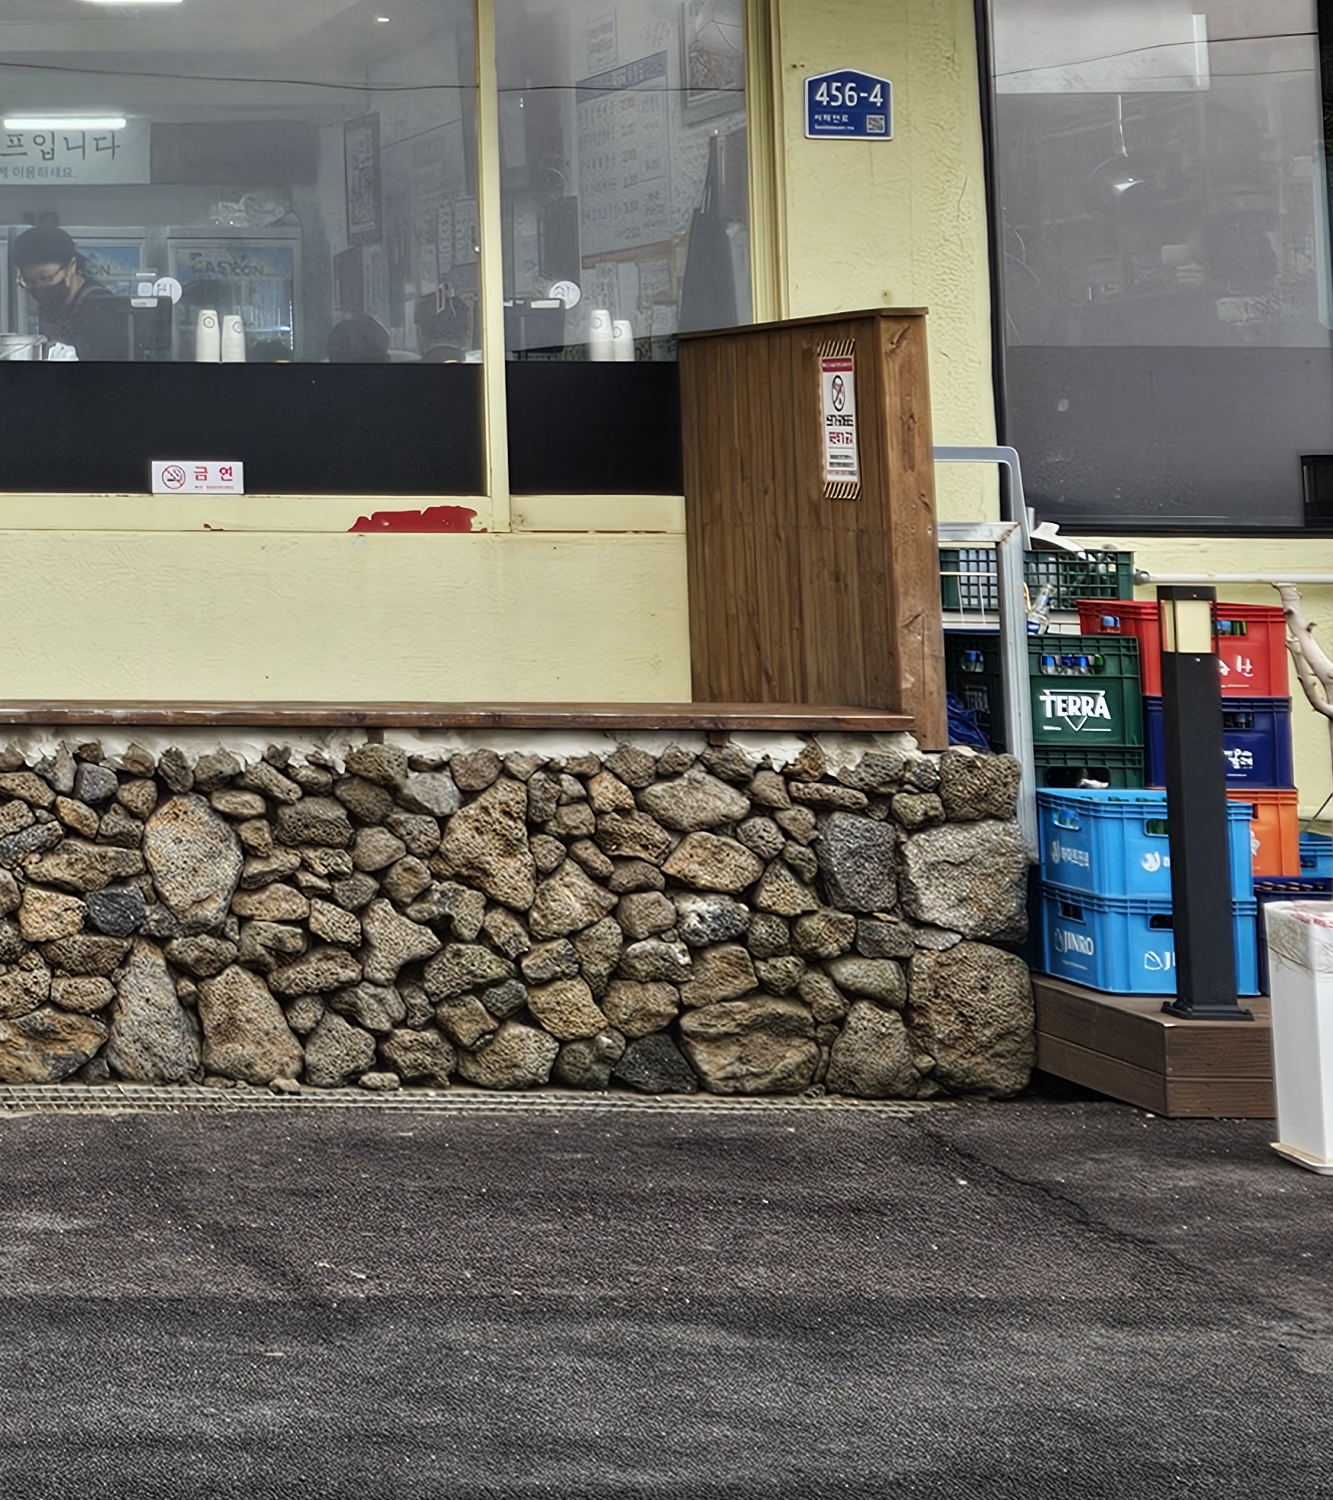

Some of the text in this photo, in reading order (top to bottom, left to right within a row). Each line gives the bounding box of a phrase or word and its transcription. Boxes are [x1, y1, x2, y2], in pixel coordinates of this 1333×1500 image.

[815, 81, 884, 107] 456-4
[1039, 695, 1111, 720] TERRA
[1064, 930, 1094, 956] JINRO
